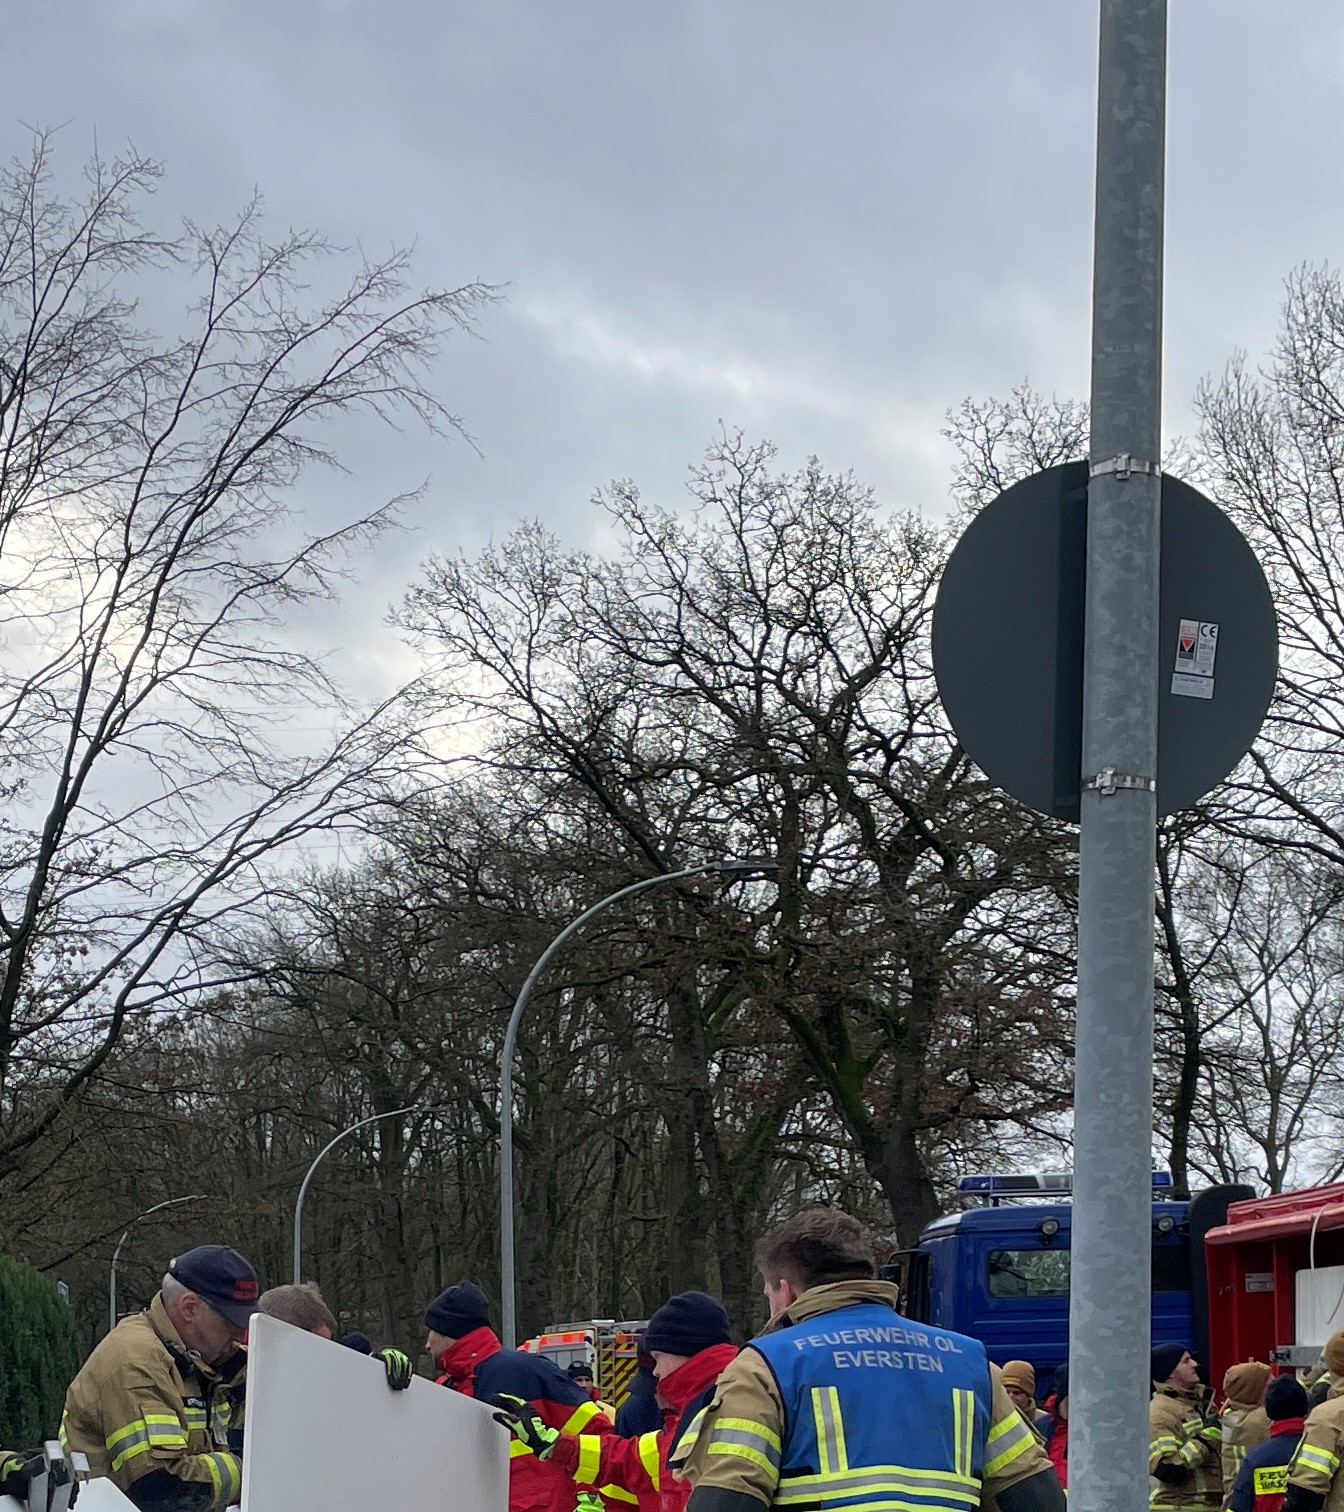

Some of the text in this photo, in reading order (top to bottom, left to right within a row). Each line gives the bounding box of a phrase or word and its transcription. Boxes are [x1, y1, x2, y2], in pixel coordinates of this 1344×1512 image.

[793, 1326, 963, 1355] FEUERWEHR OL
[833, 1350, 944, 1374] EVERSTEN
